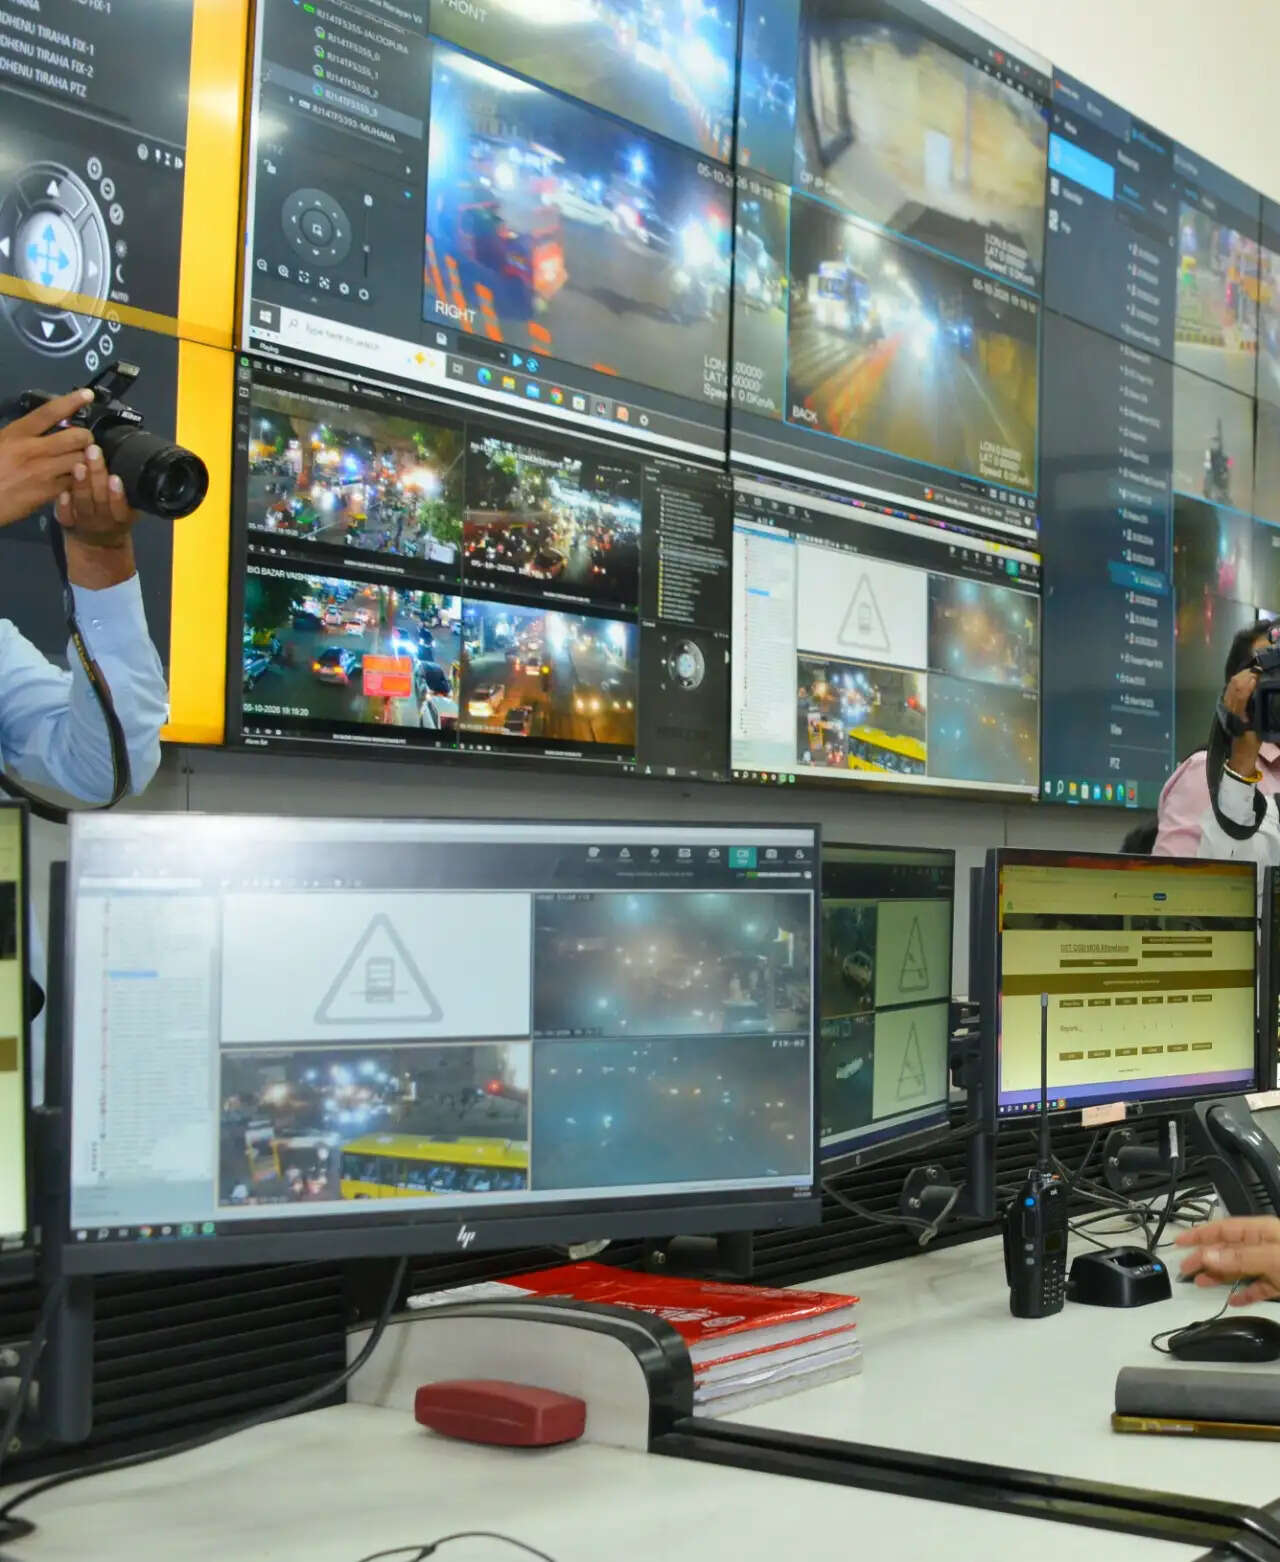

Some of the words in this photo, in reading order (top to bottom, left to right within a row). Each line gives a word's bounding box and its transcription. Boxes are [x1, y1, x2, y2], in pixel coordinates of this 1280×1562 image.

[440, 0, 488, 22] RONT
[37, 24, 71, 48] TIRAHA
[36, 46, 70, 69] TIRAHA
[35, 68, 68, 91] TIRAHA
[70, 81, 87, 98] PTZ
[435, 300, 476, 322] RIGHT
[121, 410, 142, 422] Nikon
[792, 404, 818, 425] BACK
[456, 1224, 476, 1248] hp
